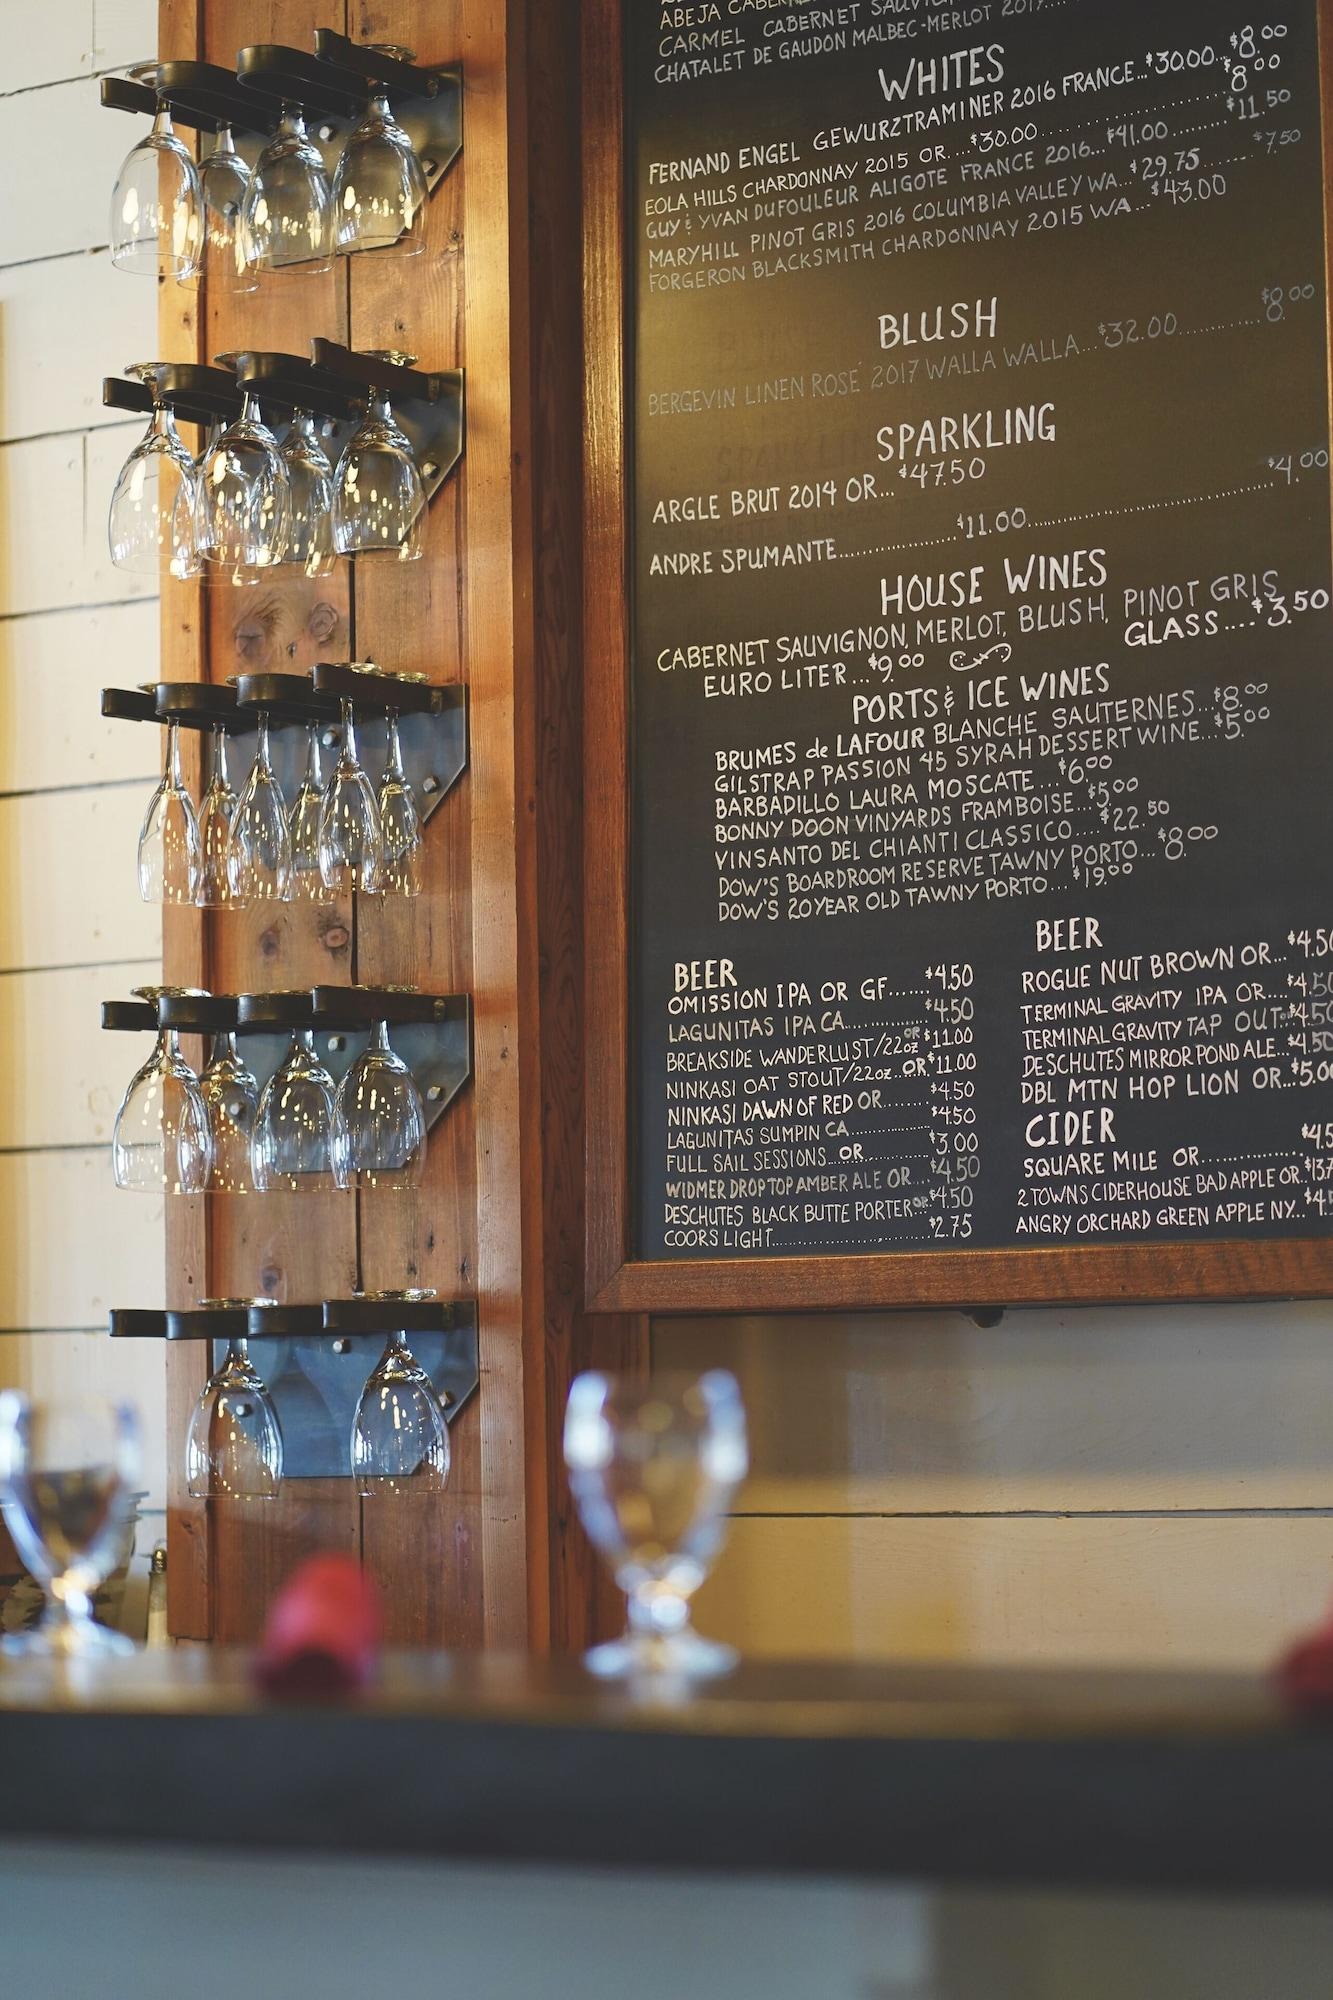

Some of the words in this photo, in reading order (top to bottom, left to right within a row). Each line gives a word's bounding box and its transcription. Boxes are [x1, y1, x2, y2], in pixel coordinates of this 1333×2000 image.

[659, 27, 745, 57] CARMEL
[763, 4, 860, 37] CABERNET
[660, 4, 721, 30] ABEJA
[655, 50, 745, 83] CHATALET
[754, 46, 772, 65] DE
[778, 30, 846, 60] GAUDON
[878, 44, 1004, 101] WHITES
[649, 152, 730, 184] FERNAND
[739, 141, 800, 169] ENGEL
[813, 93, 1003, 150] GEWURZTRAMINER
[1011, 81, 1056, 109] 2016
[1062, 61, 1134, 96] FRANCE
[645, 191, 687, 217] EOLA
[694, 184, 737, 208] HILLS
[742, 162, 858, 199] CHARDONNAY
[865, 152, 908, 174] 2015
[919, 145, 946, 164] OR
[645, 219, 681, 240] GUY
[699, 207, 749, 230] YVAN
[754, 185, 858, 221] DUFOULEUR
[870, 168, 948, 199] ALIGOTE
[960, 151, 1035, 182] FRANCE
[1045, 142, 1090, 166] 2016
[649, 242, 739, 270] MARYHILL
[751, 227, 804, 253] PINOT
[811, 219, 855, 243] GRIS
[864, 211, 905, 233] 2016
[912, 190, 1010, 223] COLUMBIA
[1015, 175, 1083, 204] VALLEY
[1089, 172, 1118, 192] WA
[650, 266, 746, 293] FORGERON
[752, 239, 875, 279] BLACKSMITH
[882, 220, 1019, 256] CHARDONNAY
[1027, 206, 1083, 233] 2015
[1090, 197, 1132, 220] WA
[877, 297, 998, 349] BLUSH
[877, 403, 1056, 461] SPARKLING
[652, 495, 720, 524] ARGLE
[731, 487, 780, 517] BRUT
[788, 480, 837, 509] 2014
[846, 474, 876, 503] OR
[650, 551, 713, 576] ANDRE
[720, 538, 837, 573] SPUMANTE
[880, 566, 984, 616] HOUSE
[1004, 548, 1107, 594] WINES
[657, 639, 769, 672] CABERNET
[1124, 580, 1199, 618] PINOT
[1210, 570, 1278, 601] GRIS
[704, 671, 772, 698] EURO
[781, 662, 846, 690] LITER
[1124, 610, 1219, 647] GLASS
[853, 688, 938, 725] PORTS
[968, 676, 1009, 711] ICE
[1020, 663, 1110, 701] WINES
[715, 741, 796, 772] BRUMES
[836, 727, 925, 758] LAFOUR
[933, 711, 1037, 746] BLANCHE
[1052, 690, 1194, 729] SAUTERNES
[715, 768, 815, 795] GILSTRAP
[821, 755, 911, 786] PASSION
[956, 738, 1031, 768] SYRAH
[1038, 726, 1132, 756] DESSERT
[1137, 720, 1200, 745] WINE
[715, 792, 840, 820] BARBADILLO
[850, 783, 918, 810] LAURA
[928, 769, 1034, 800] MOSCATE
[715, 819, 784, 843] BONNY
[791, 816, 848, 838] DOON
[855, 806, 951, 833] VINYARDS
[962, 792, 1073, 821] FRAMBOISE
[715, 844, 822, 871] VINSANTO
[831, 840, 861, 861] DEL
[869, 831, 958, 859] CHIANTI
[965, 820, 1072, 850] CLASSICO
[786, 866, 895, 894] BOARDROOM
[901, 855, 984, 883] RESERVE
[989, 848, 1064, 875] TAWNY
[1071, 839, 1137, 868] PORTO
[865, 889, 900, 910] OLD
[905, 883, 979, 908] TAWNY
[985, 876, 1048, 900] PORTO
[1036, 917, 1103, 951] BEER
[674, 958, 737, 993] BEER
[1021, 965, 1091, 994] ROGUE
[1101, 956, 1143, 986] NUT
[1150, 945, 1233, 979] BROWN
[1241, 942, 1271, 965] OR
[668, 987, 767, 1015] OMISSION
[777, 982, 812, 1008] IPA
[820, 981, 848, 1002] OR
[860, 977, 887, 1001] GF
[1020, 997, 1108, 1025] TERMINAL
[1112, 990, 1182, 1014] GRAVITY
[1196, 985, 1227, 1006] IPA
[1236, 982, 1266, 1003] OR
[669, 1016, 774, 1043] LAGUNITAS
[785, 1015, 816, 1037] IPA
[821, 1010, 845, 1032] CA
[1022, 1026, 1110, 1051] TERMINAL
[1111, 1020, 1182, 1042] GRAVITY
[1187, 1014, 1222, 1037] TAP
[1235, 1007, 1282, 1032] OUT
[666, 1080, 736, 1100] NINKASI
[744, 1076, 779, 1094] OAT
[902, 1058, 926, 1075] OR
[667, 1048, 752, 1073] BREAKSIDE
[1022, 1047, 1125, 1078] DESCHUTES
[1129, 1045, 1193, 1069] MIRROR
[1196, 1043, 1240, 1065] POND
[1243, 1038, 1276, 1059] ALE
[1021, 1081, 1056, 1104] DBL
[1068, 1077, 1118, 1103] MTN
[1129, 1075, 1175, 1100] HOP
[1186, 1069, 1239, 1096] LION
[1252, 1067, 1282, 1089] OR
[668, 1104, 736, 1127] NINKASI
[743, 1098, 792, 1122] DAWN
[797, 1095, 818, 1116] OF
[823, 1094, 853, 1115] RED
[858, 1089, 882, 1110] OR
[1025, 1107, 1116, 1148] CIDER
[668, 1128, 754, 1150] LAGUNITAS
[760, 1124, 820, 1144] SUMPIN
[825, 1120, 849, 1137] CA
[666, 1155, 707, 1173] FULL
[713, 1153, 749, 1172] SAIL
[754, 1147, 826, 1171] SESSIONS
[839, 1143, 864, 1160] OR
[1023, 1152, 1105, 1178] SQUARE
[1113, 1150, 1157, 1172] MILE
[1173, 1146, 1199, 1167] OR
[665, 1180, 726, 1199] WIDMER
[796, 1173, 848, 1195] AMBER
[852, 1170, 882, 1190] ALE
[887, 1166, 911, 1188] OR
[1091, 1176, 1192, 1201] CIDERHOUSE
[1196, 1171, 1227, 1194] BAD
[1230, 1168, 1276, 1190] APPLE
[1279, 1165, 1300, 1184] OR
[665, 1203, 744, 1226] DESCHUTES
[752, 1205, 799, 1224] BLACK
[804, 1203, 850, 1224] BUTTE
[855, 1199, 913, 1221] PORTER
[1016, 1214, 1072, 1235] ANGRY
[1076, 1209, 1151, 1234] ORCHARD
[1156, 1205, 1209, 1227] GREEN
[1215, 1202, 1265, 1223] APPLE
[1270, 1200, 1296, 1220] NY
[664, 1229, 719, 1247] COORS
[723, 1228, 774, 1248] LIGHT
